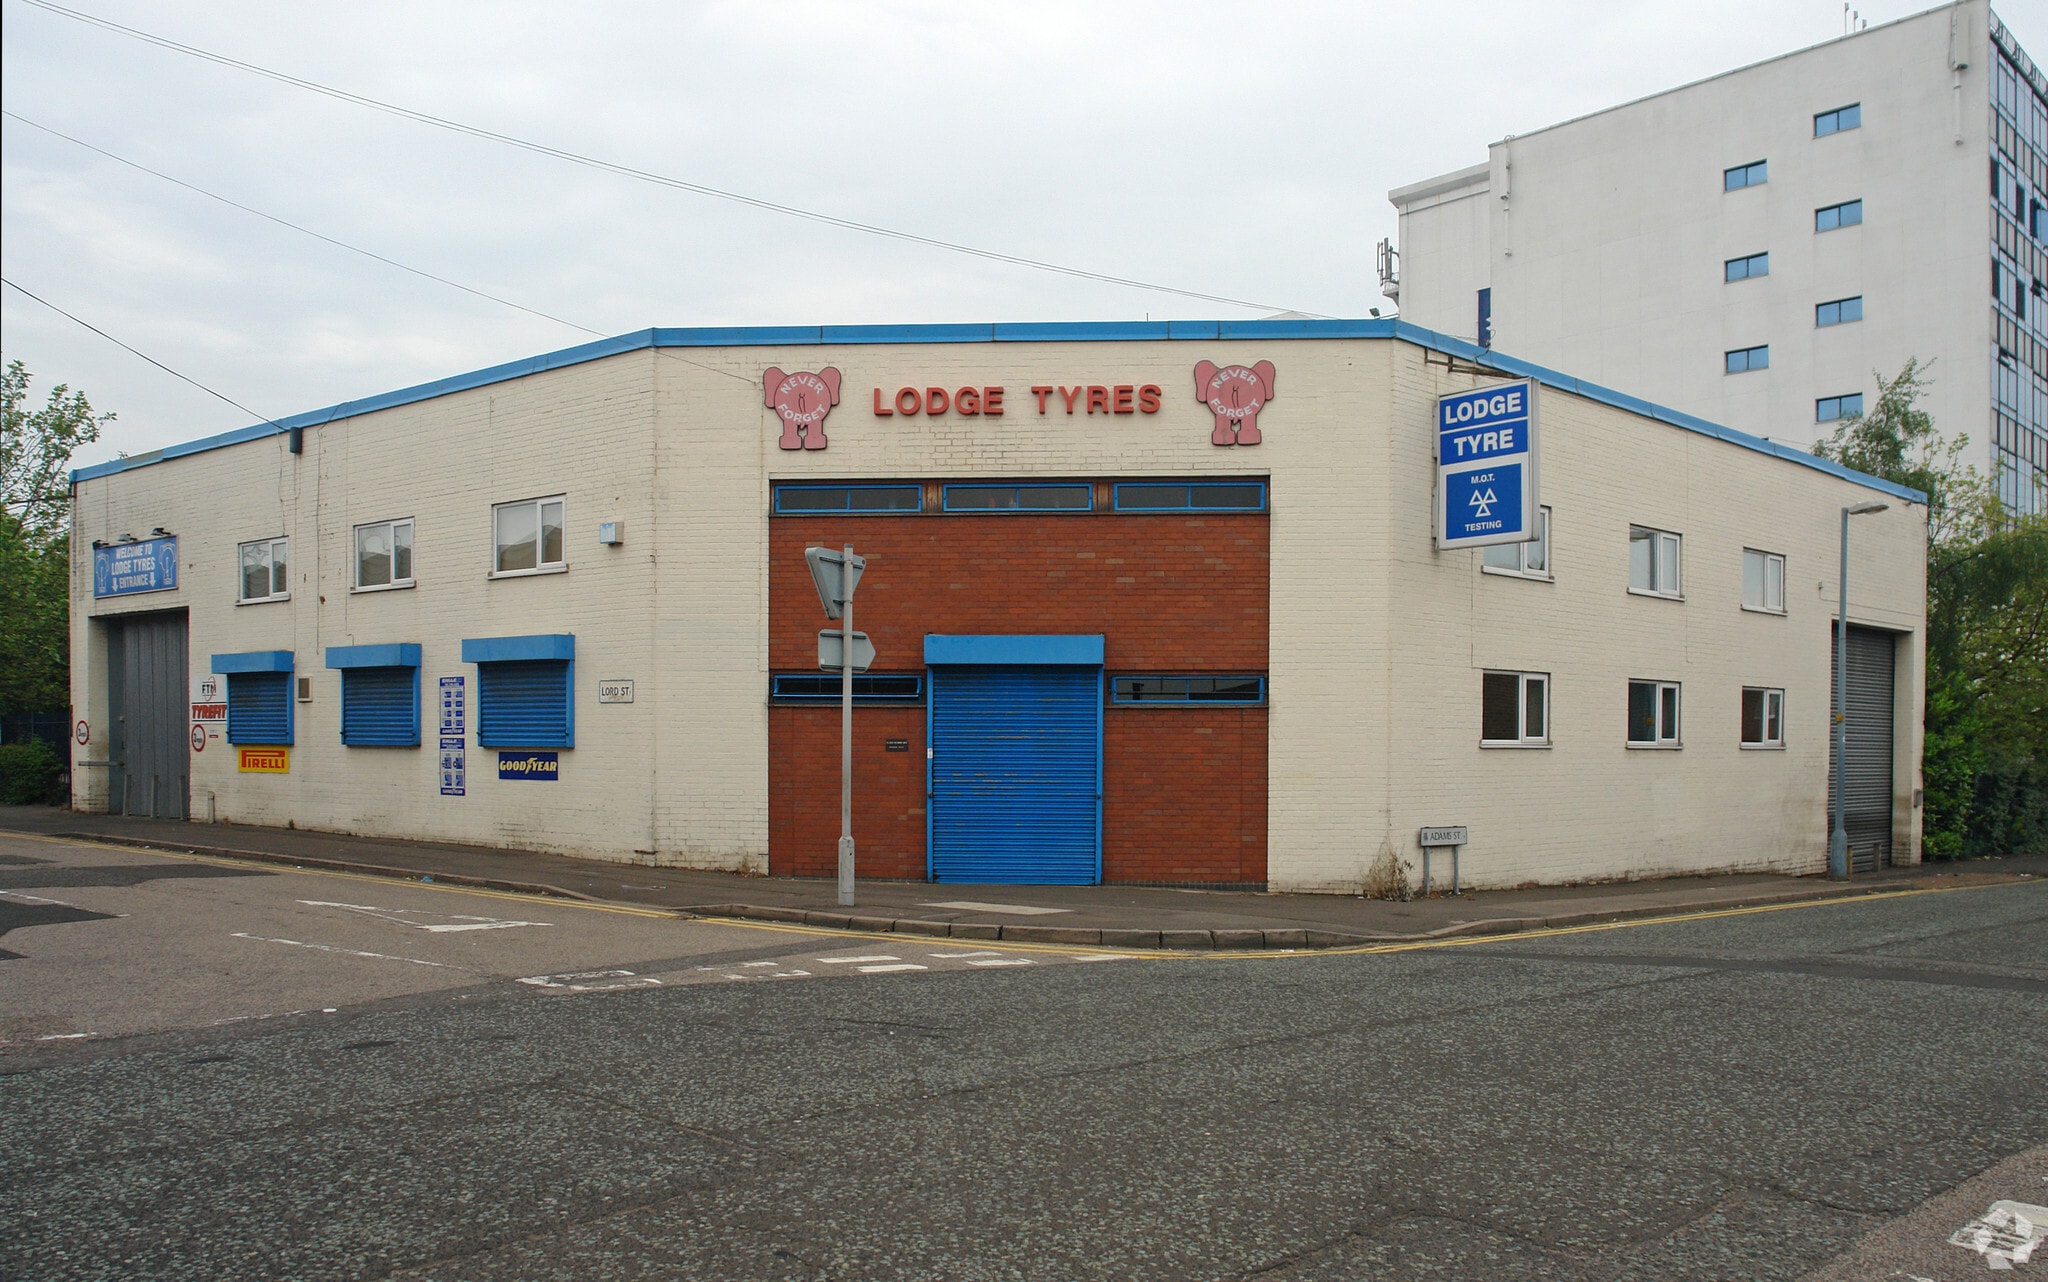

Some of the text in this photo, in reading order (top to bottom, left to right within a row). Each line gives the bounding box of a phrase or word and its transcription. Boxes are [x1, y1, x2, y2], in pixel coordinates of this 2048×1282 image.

[780, 376, 824, 394] NEVER
[1212, 369, 1257, 389] NEVER
[874, 384, 1162, 416] LODGE TYRES
[1211, 398, 1259, 418] FORGET
[1445, 391, 1522, 424] LODGE
[778, 403, 825, 422] FORGET
[1453, 428, 1514, 457] TYRE
[1471, 473, 1495, 484] M.O.T.
[1465, 520, 1502, 532] TESTING
[116, 543, 153, 559] WELCOME TO
[111, 557, 155, 575] LODGE TYRES
[119, 574, 148, 589] ENTRANCE
[601, 686, 619, 696] LORD
[241, 749, 285, 769] PIRELLI
[1429, 832, 1452, 841] ADAMS
